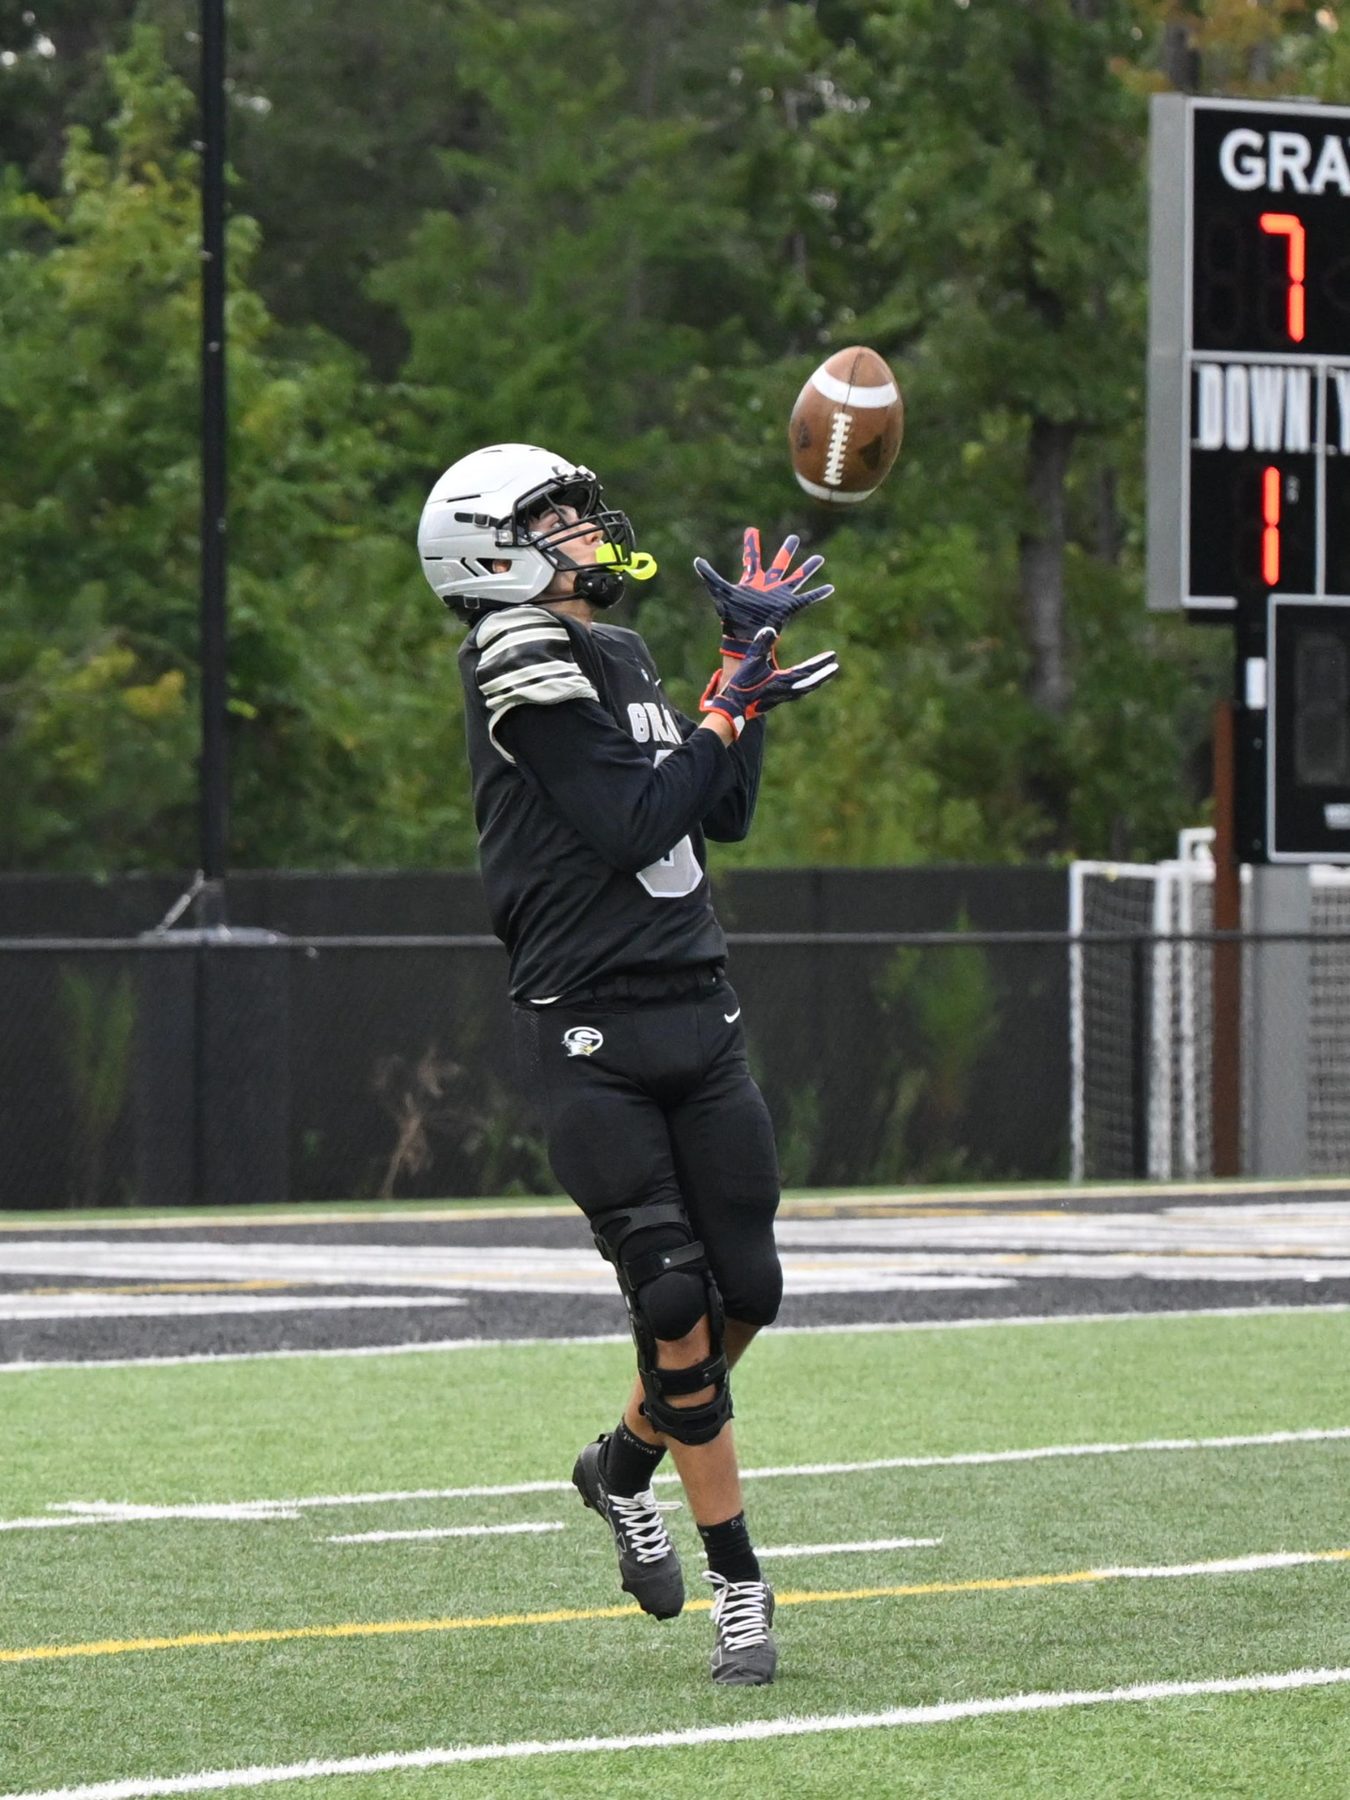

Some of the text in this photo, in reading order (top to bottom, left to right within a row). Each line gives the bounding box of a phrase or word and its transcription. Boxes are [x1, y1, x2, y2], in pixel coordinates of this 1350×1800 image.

[1219, 128, 1350, 197] GRA
[1260, 213, 1305, 343] 7
[1198, 363, 1311, 454] DOWN
[1262, 466, 1280, 586] 1
